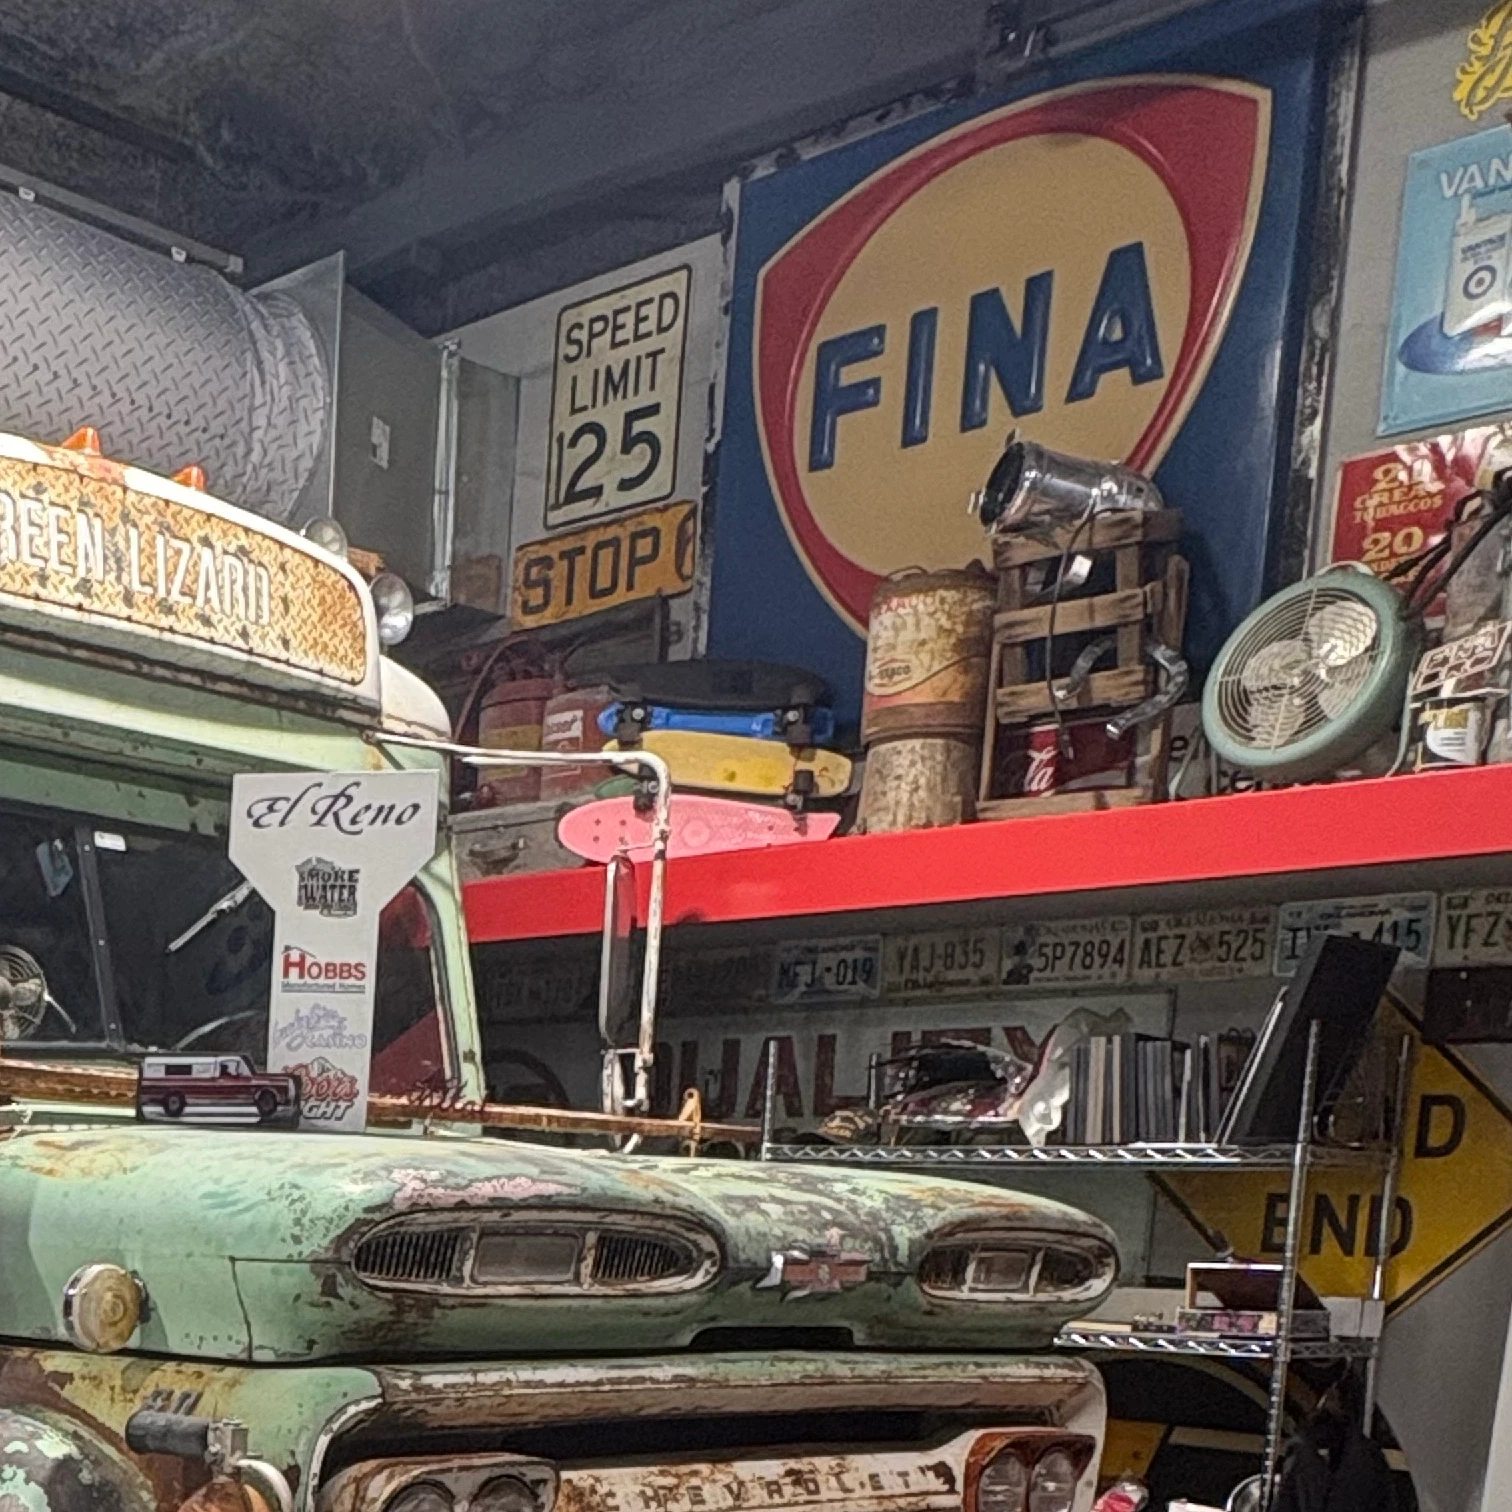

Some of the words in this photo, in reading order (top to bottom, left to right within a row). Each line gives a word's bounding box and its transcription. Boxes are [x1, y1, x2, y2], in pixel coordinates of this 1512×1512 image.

[563, 291, 679, 363] SPEED
[808, 240, 1164, 473] FINA
[569, 348, 665, 416] LIMIT
[521, 525, 662, 616] STOP
[1362, 526, 1425, 562] 20
[128, 525, 272, 627] LIZARD
[247, 782, 324, 830] El
[309, 781, 422, 836] Reno
[282, 951, 367, 980] HOBBS
[1036, 938, 1127, 973] 5P7894
[1138, 933, 1187, 970] AEZ
[1217, 927, 1267, 963] 525
[1260, 1191, 1414, 1259] END
[602, 1470, 912, 1512] CHEVROLET
